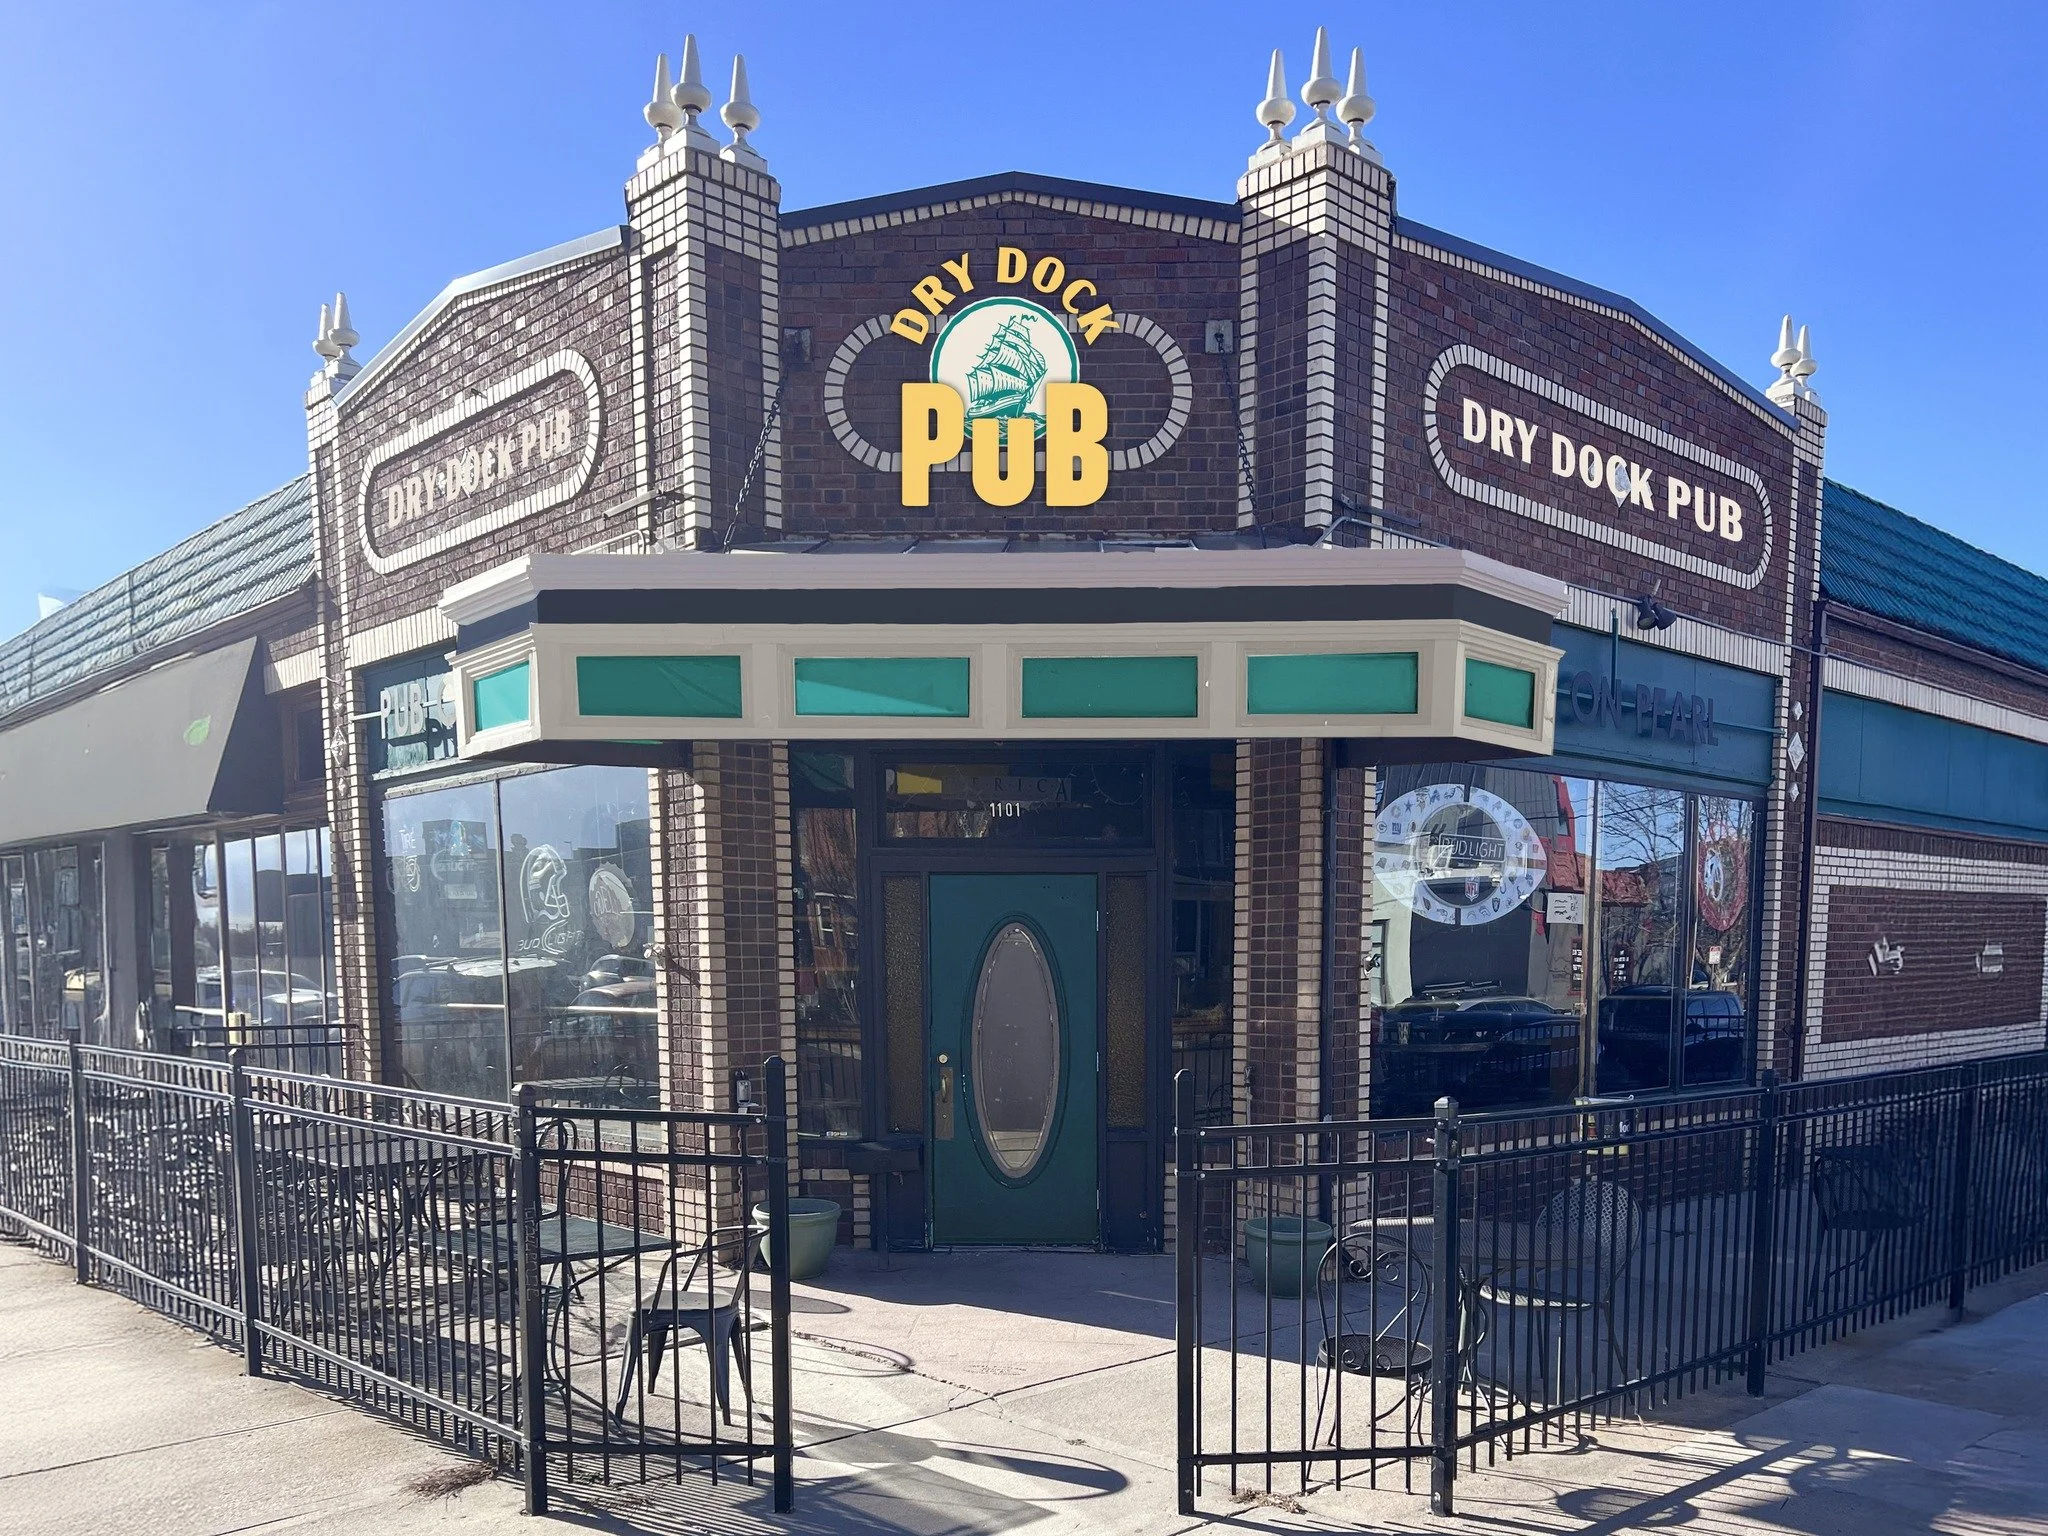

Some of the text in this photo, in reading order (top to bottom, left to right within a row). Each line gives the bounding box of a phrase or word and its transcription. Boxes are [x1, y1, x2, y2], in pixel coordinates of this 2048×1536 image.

[890, 246, 1121, 346] DRY DOCK
[388, 408, 572, 529] DRY DOCK PUB
[901, 382, 1109, 507] PUB
[1462, 397, 1743, 543] DRY DOCK PUB
[380, 683, 425, 740] PUB
[1571, 670, 1719, 746] ON PEARL
[989, 802, 1021, 817] 1101
